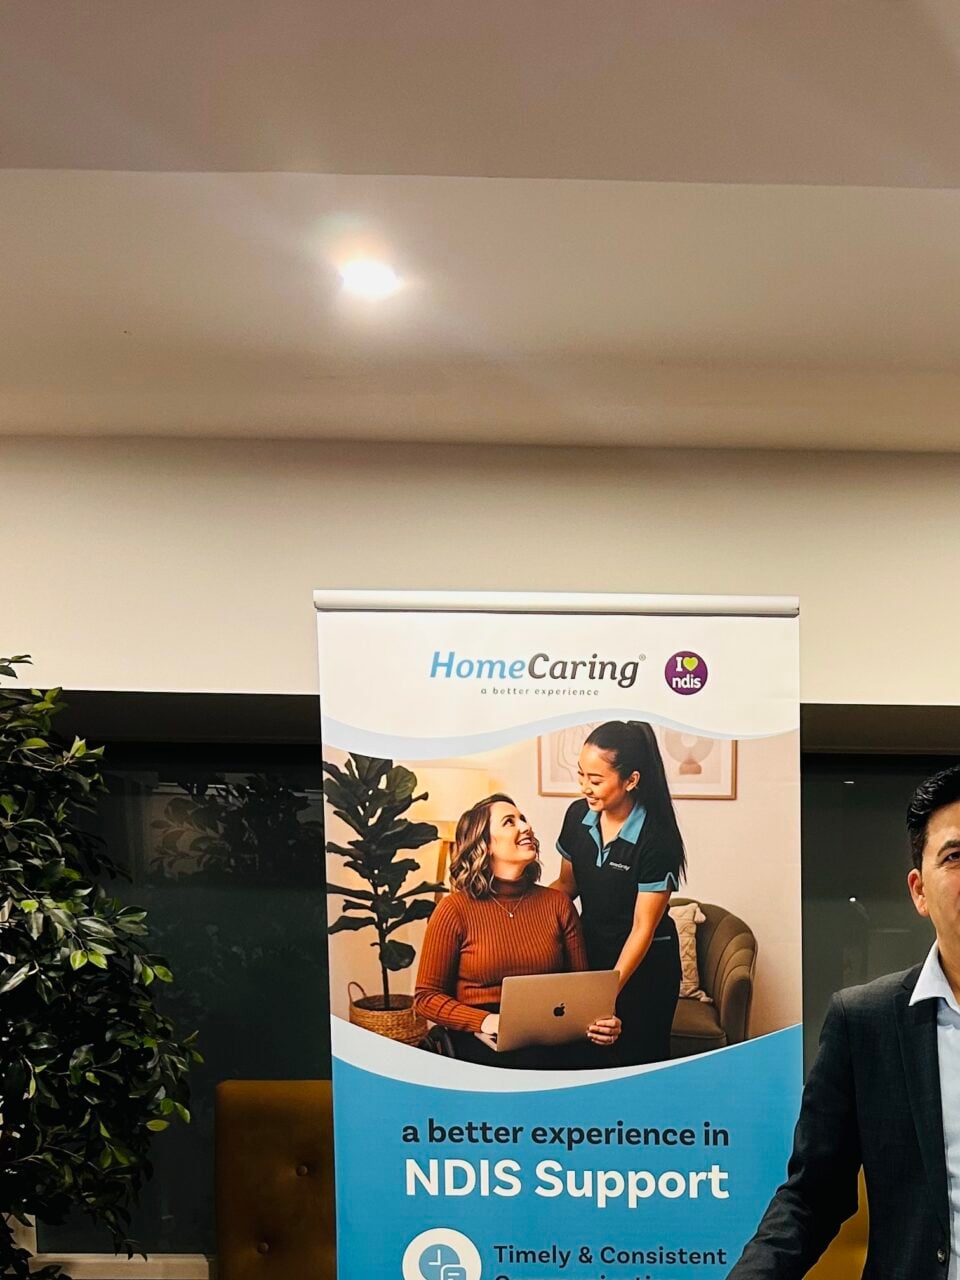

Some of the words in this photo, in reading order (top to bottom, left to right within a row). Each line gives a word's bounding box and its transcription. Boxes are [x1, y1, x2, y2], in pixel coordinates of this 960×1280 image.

[493, 687, 529, 695] better
[535, 688, 599, 697] experience
[672, 675, 701, 689] ndis
[402, 1126, 419, 1143] a
[428, 1118, 523, 1144] better
[531, 1120, 696, 1151] experience
[704, 1121, 729, 1146] in
[406, 1158, 522, 1197] NDIS
[534, 1159, 730, 1208] Support
[494, 1245, 571, 1268] Timely
[579, 1247, 593, 1264] &
[600, 1246, 727, 1265] Consistent
